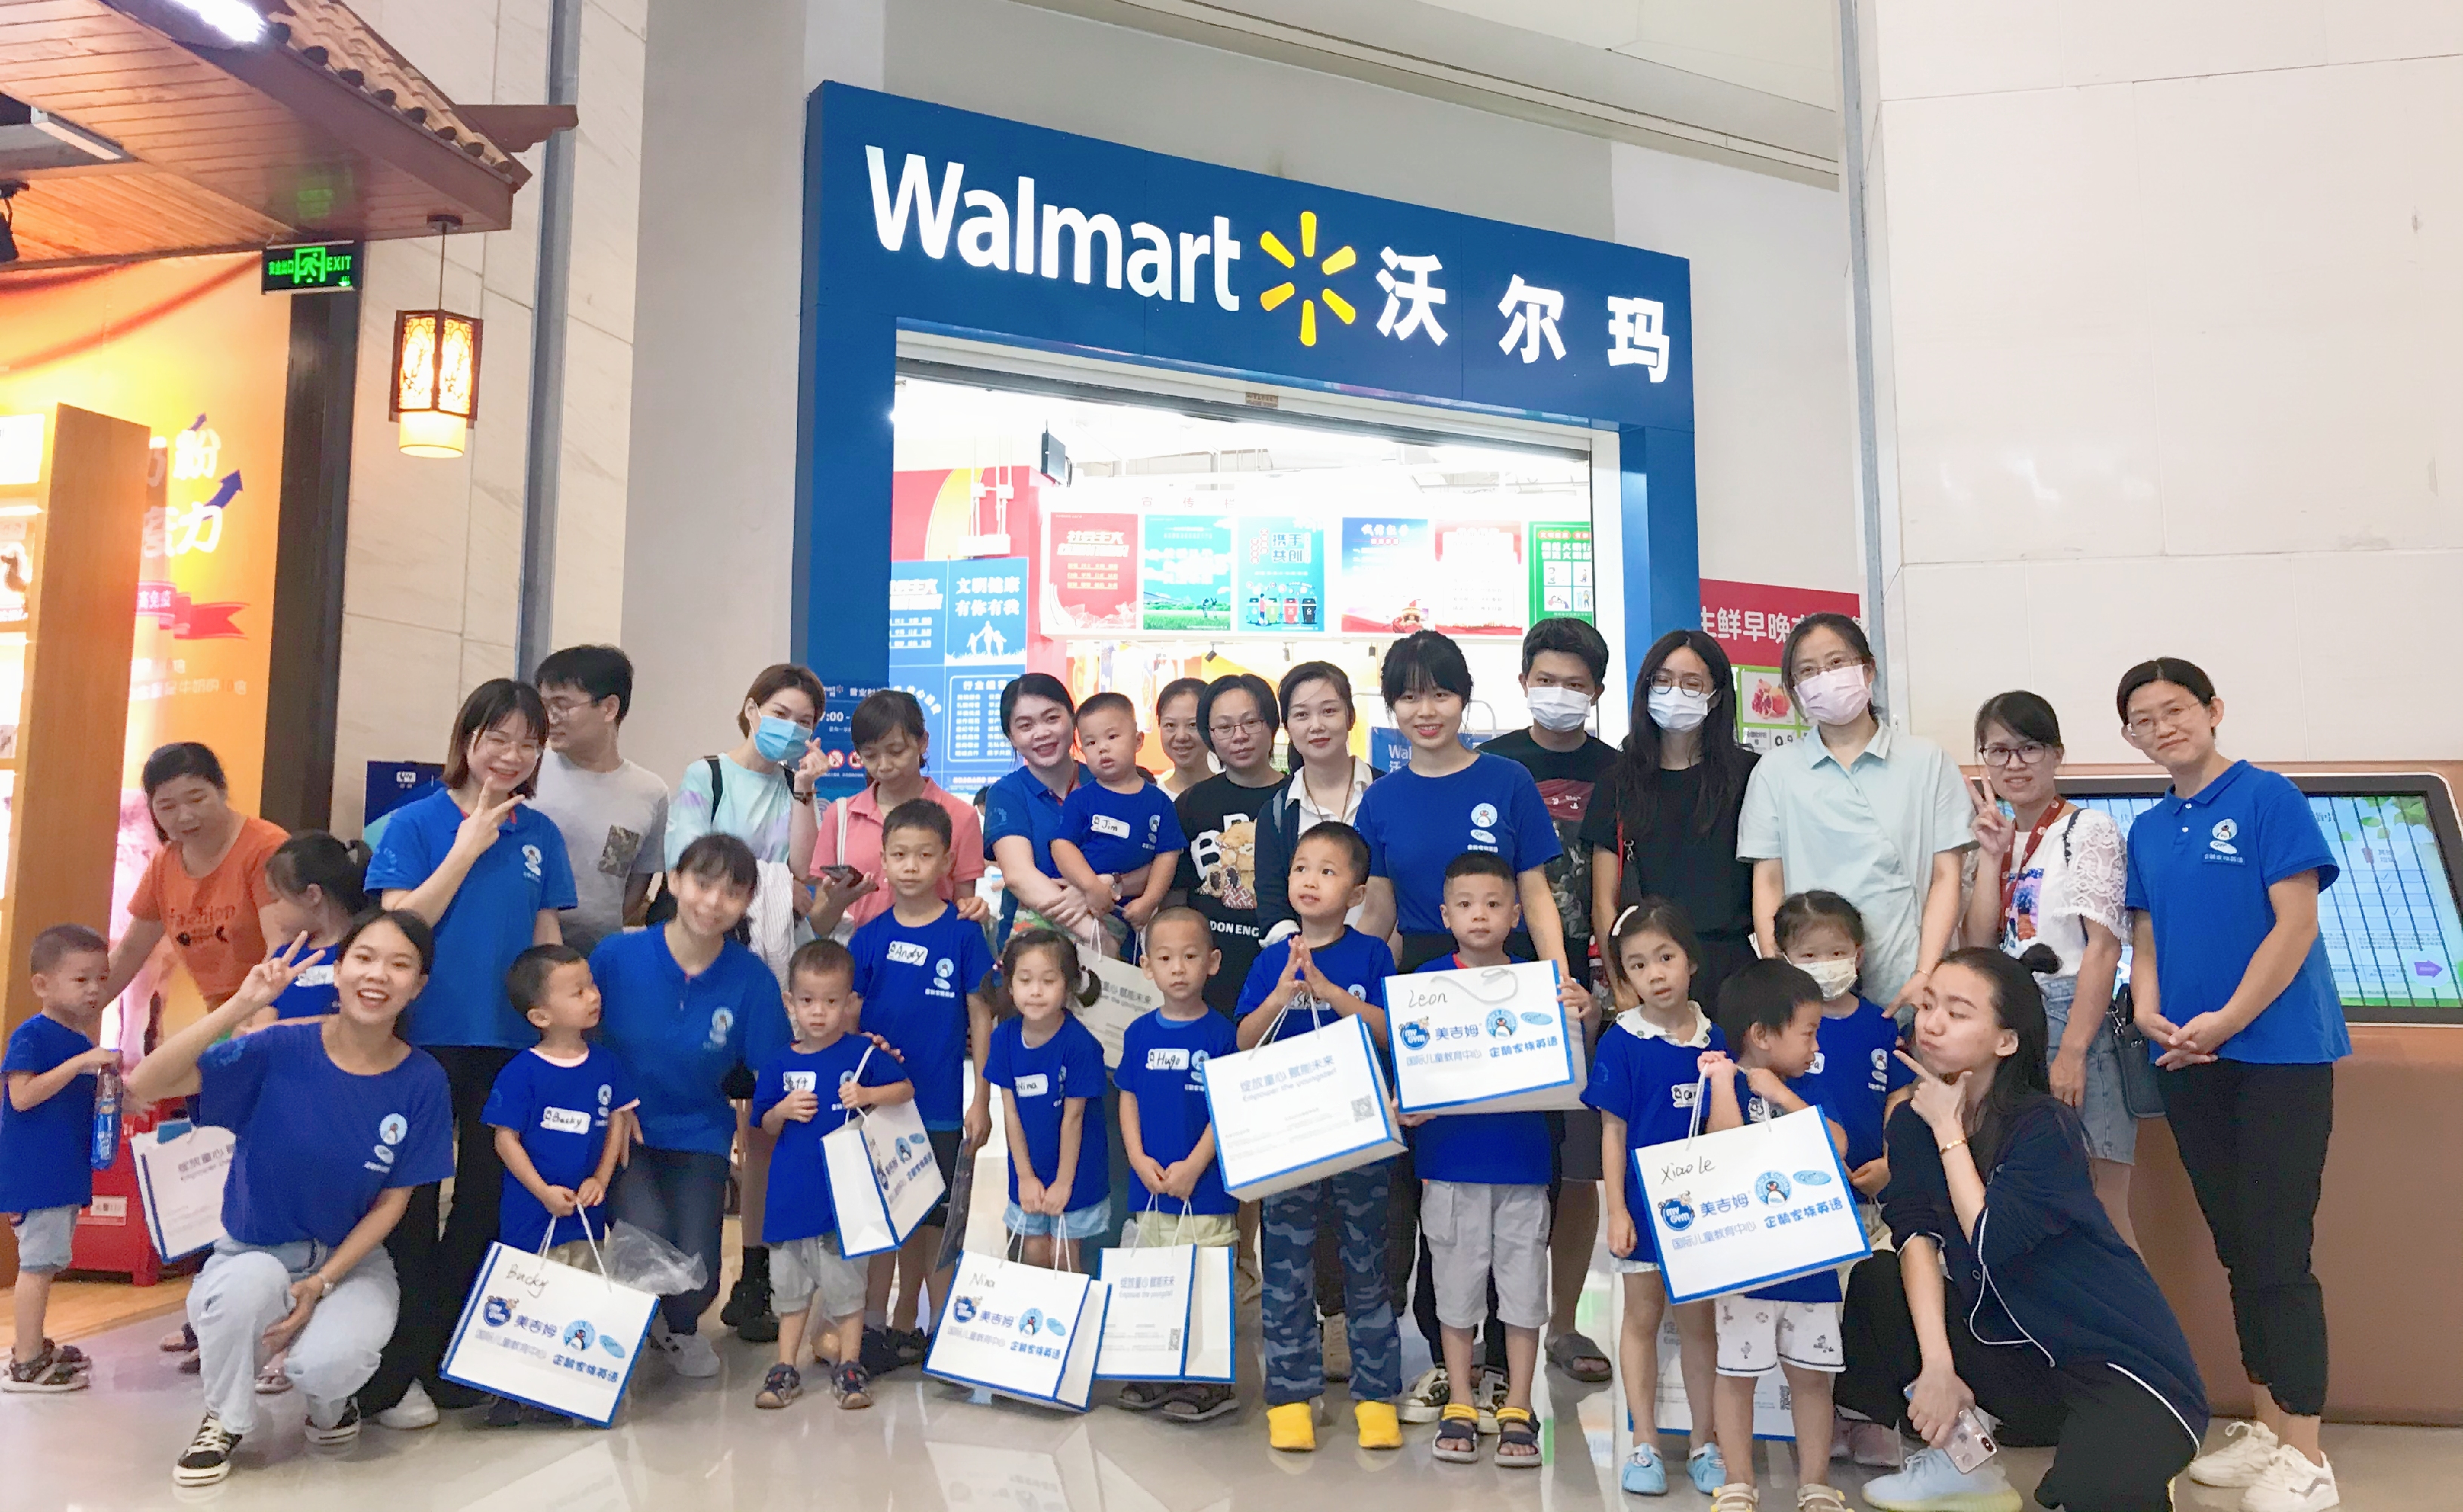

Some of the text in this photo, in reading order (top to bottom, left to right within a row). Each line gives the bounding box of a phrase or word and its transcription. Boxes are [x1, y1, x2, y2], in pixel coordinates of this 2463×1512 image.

[866, 145, 1240, 312] Walmart
[326, 256, 352, 271] EXIT
[1376, 246, 1670, 383] 沃尔玛
[1272, 533, 1304, 546] 携手
[1272, 549, 1303, 562] 共创
[956, 576, 1020, 594] 文明健康
[955, 599, 1019, 616] 有你有我
[1102, 819, 1118, 831] Jim
[1408, 990, 1448, 1008] Leon
[1435, 1024, 1479, 1040] 美吉姆
[1407, 1049, 1482, 1066] 国际儿童教育中心
[1700, 1193, 1749, 1218] 美吉姆
[1671, 1221, 1757, 1250] 国际儿童教育中心
